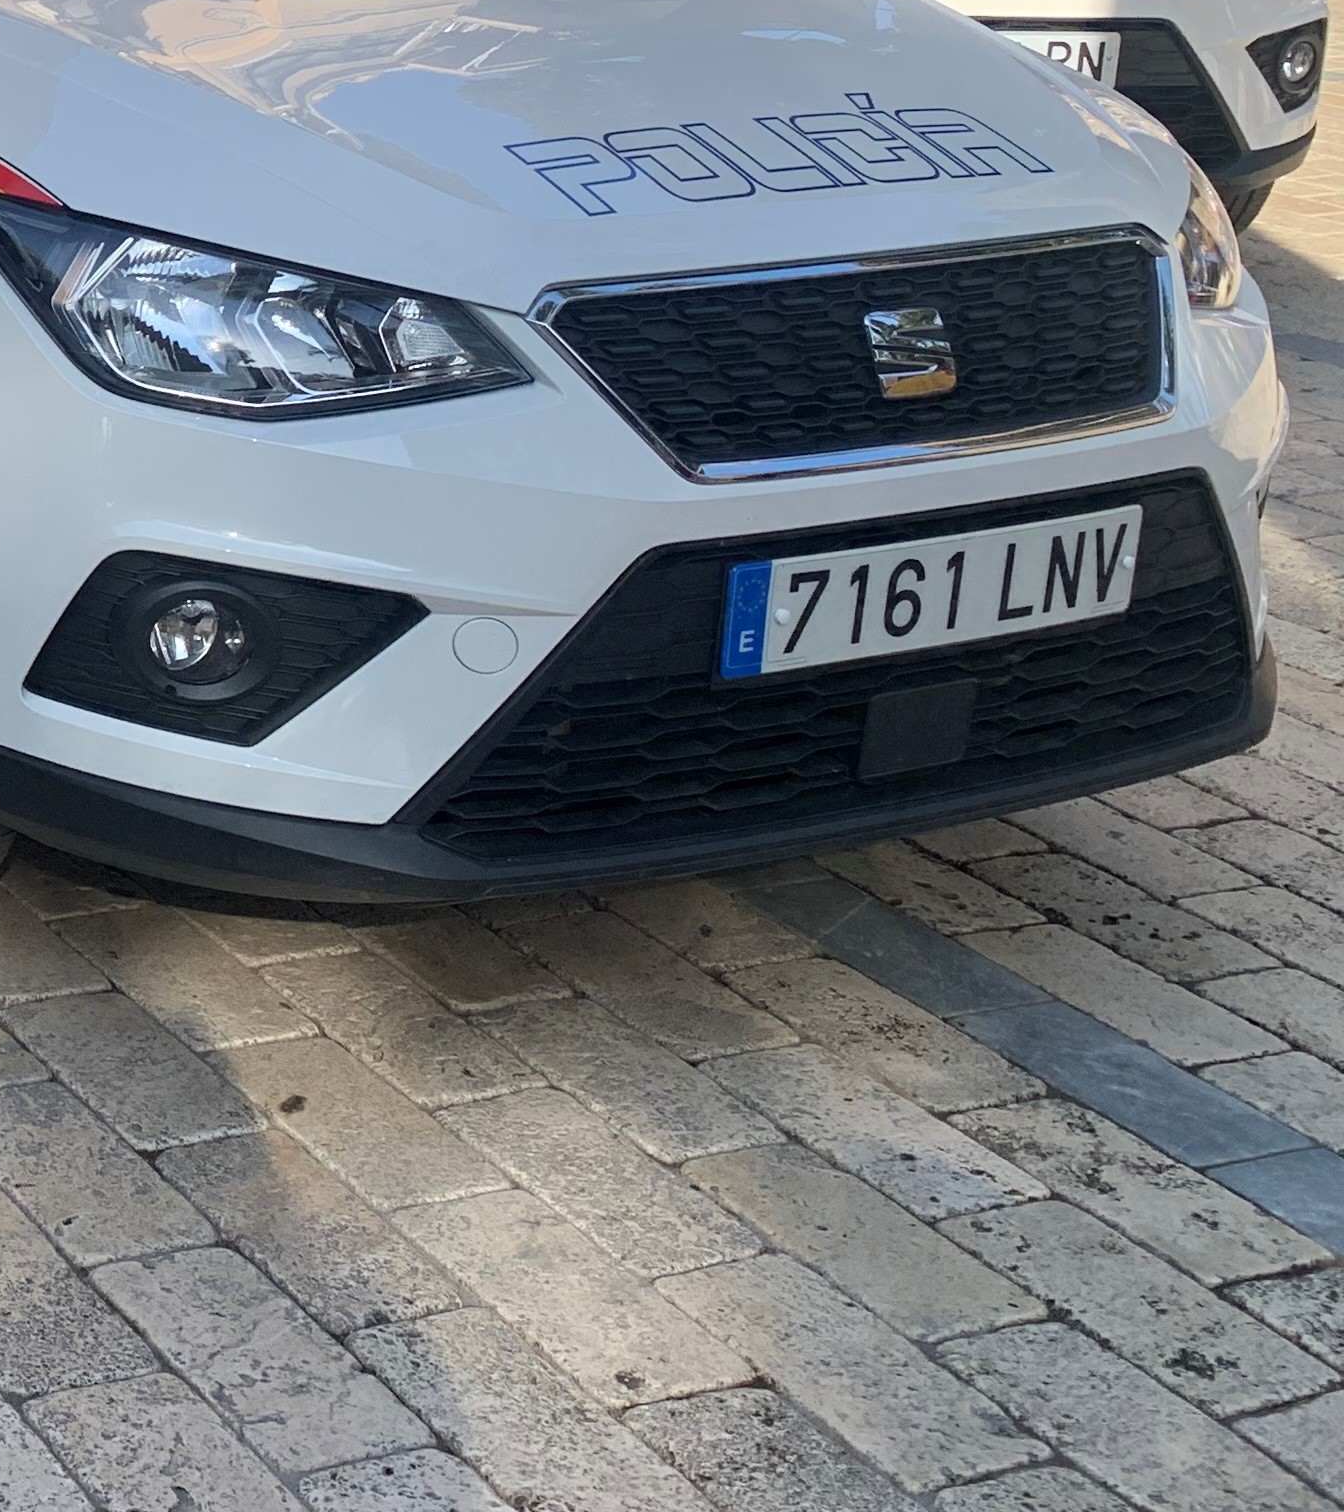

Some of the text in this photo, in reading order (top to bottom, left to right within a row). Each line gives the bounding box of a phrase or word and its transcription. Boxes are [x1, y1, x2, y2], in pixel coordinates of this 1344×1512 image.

[503, 93, 1055, 216] POLICÍA
[738, 630, 755, 653] E
[783, 523, 1128, 655] 7161 LNV
